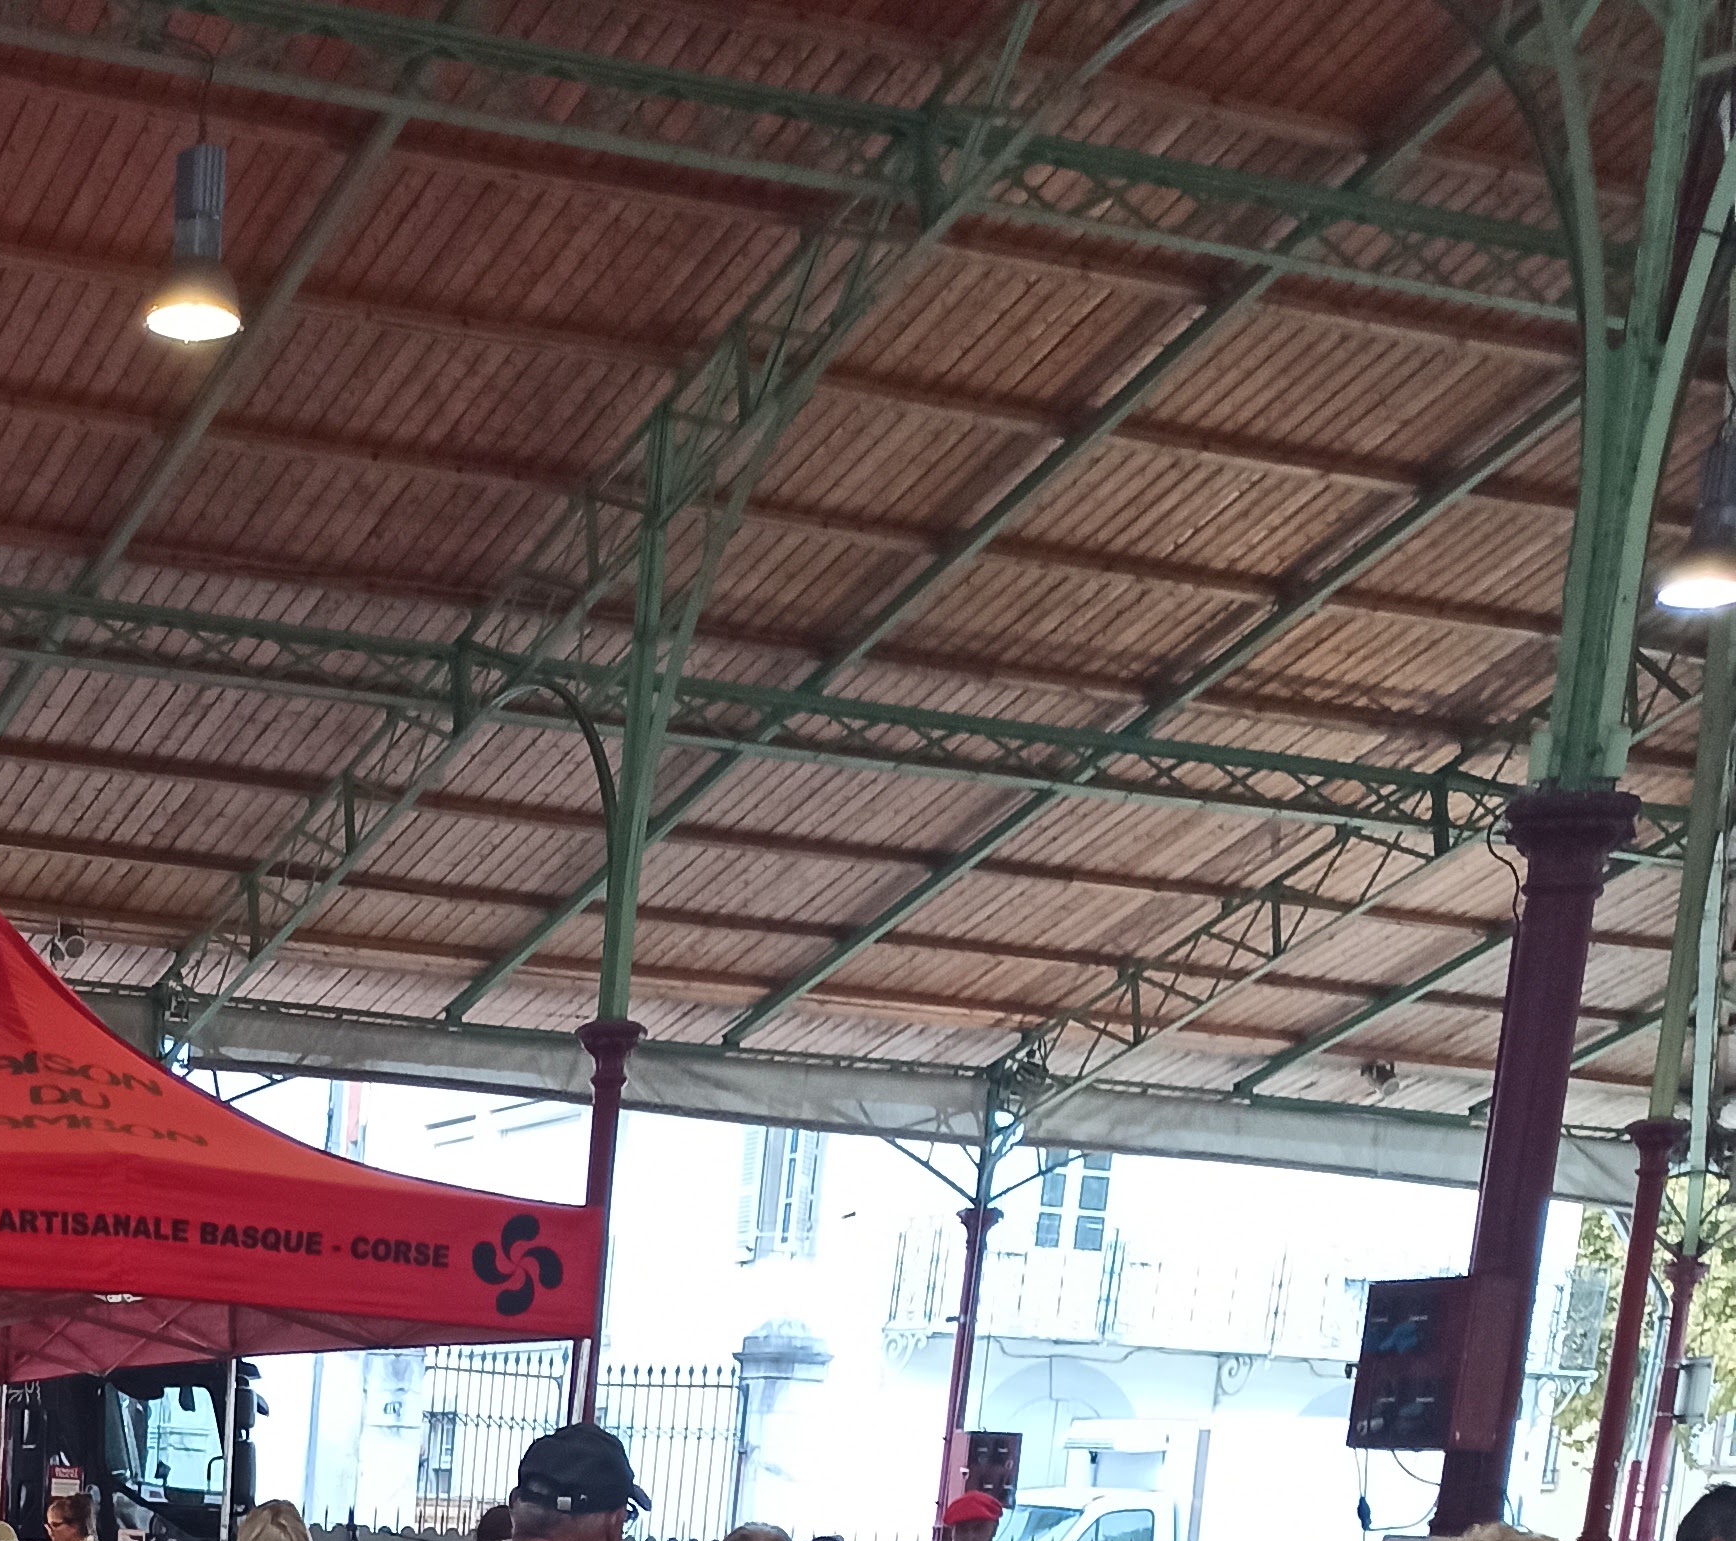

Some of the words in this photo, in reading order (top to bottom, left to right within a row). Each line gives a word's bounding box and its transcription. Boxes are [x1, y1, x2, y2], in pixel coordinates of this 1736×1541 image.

[29, 1083, 111, 1110] DU
[199, 1221, 324, 1257] BASQUE
[349, 1236, 451, 1270] CORSE
